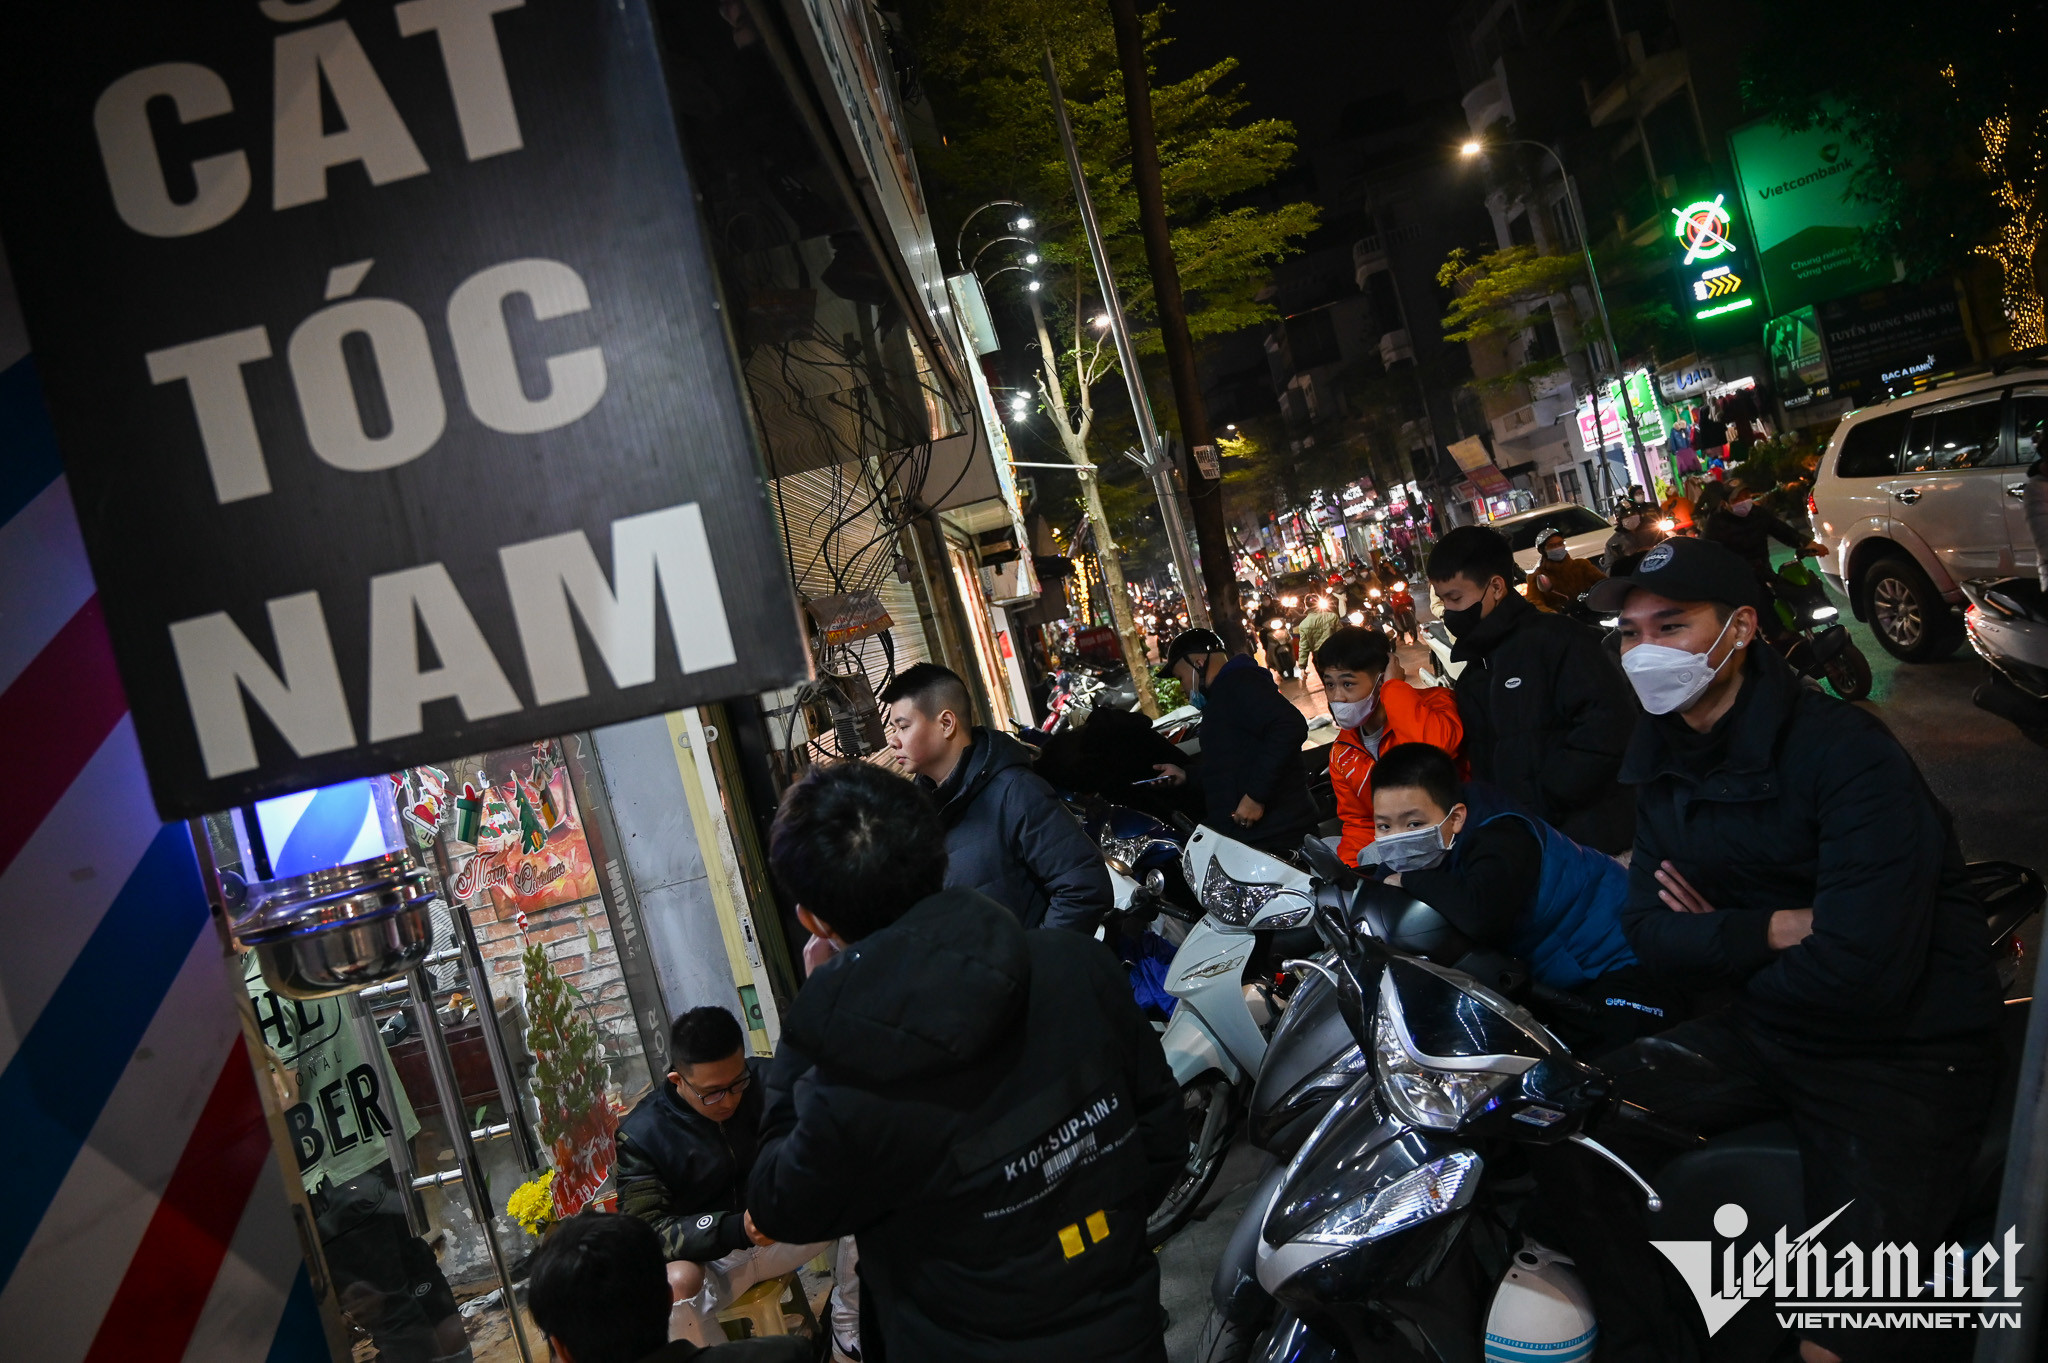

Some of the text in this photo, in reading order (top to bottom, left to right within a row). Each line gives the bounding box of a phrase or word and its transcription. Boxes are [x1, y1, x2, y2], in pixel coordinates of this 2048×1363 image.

[1758, 157, 1853, 200] Vietcombank
[1791, 255, 1822, 271] Chung
[145, 258, 607, 504] TÓC
[1881, 369, 1900, 382] BAC
[1909, 361, 1932, 374] BANK
[168, 501, 737, 780] NAM
[453, 851, 567, 900] Merry Christmas
[605, 858, 637, 946] TAKUMI
